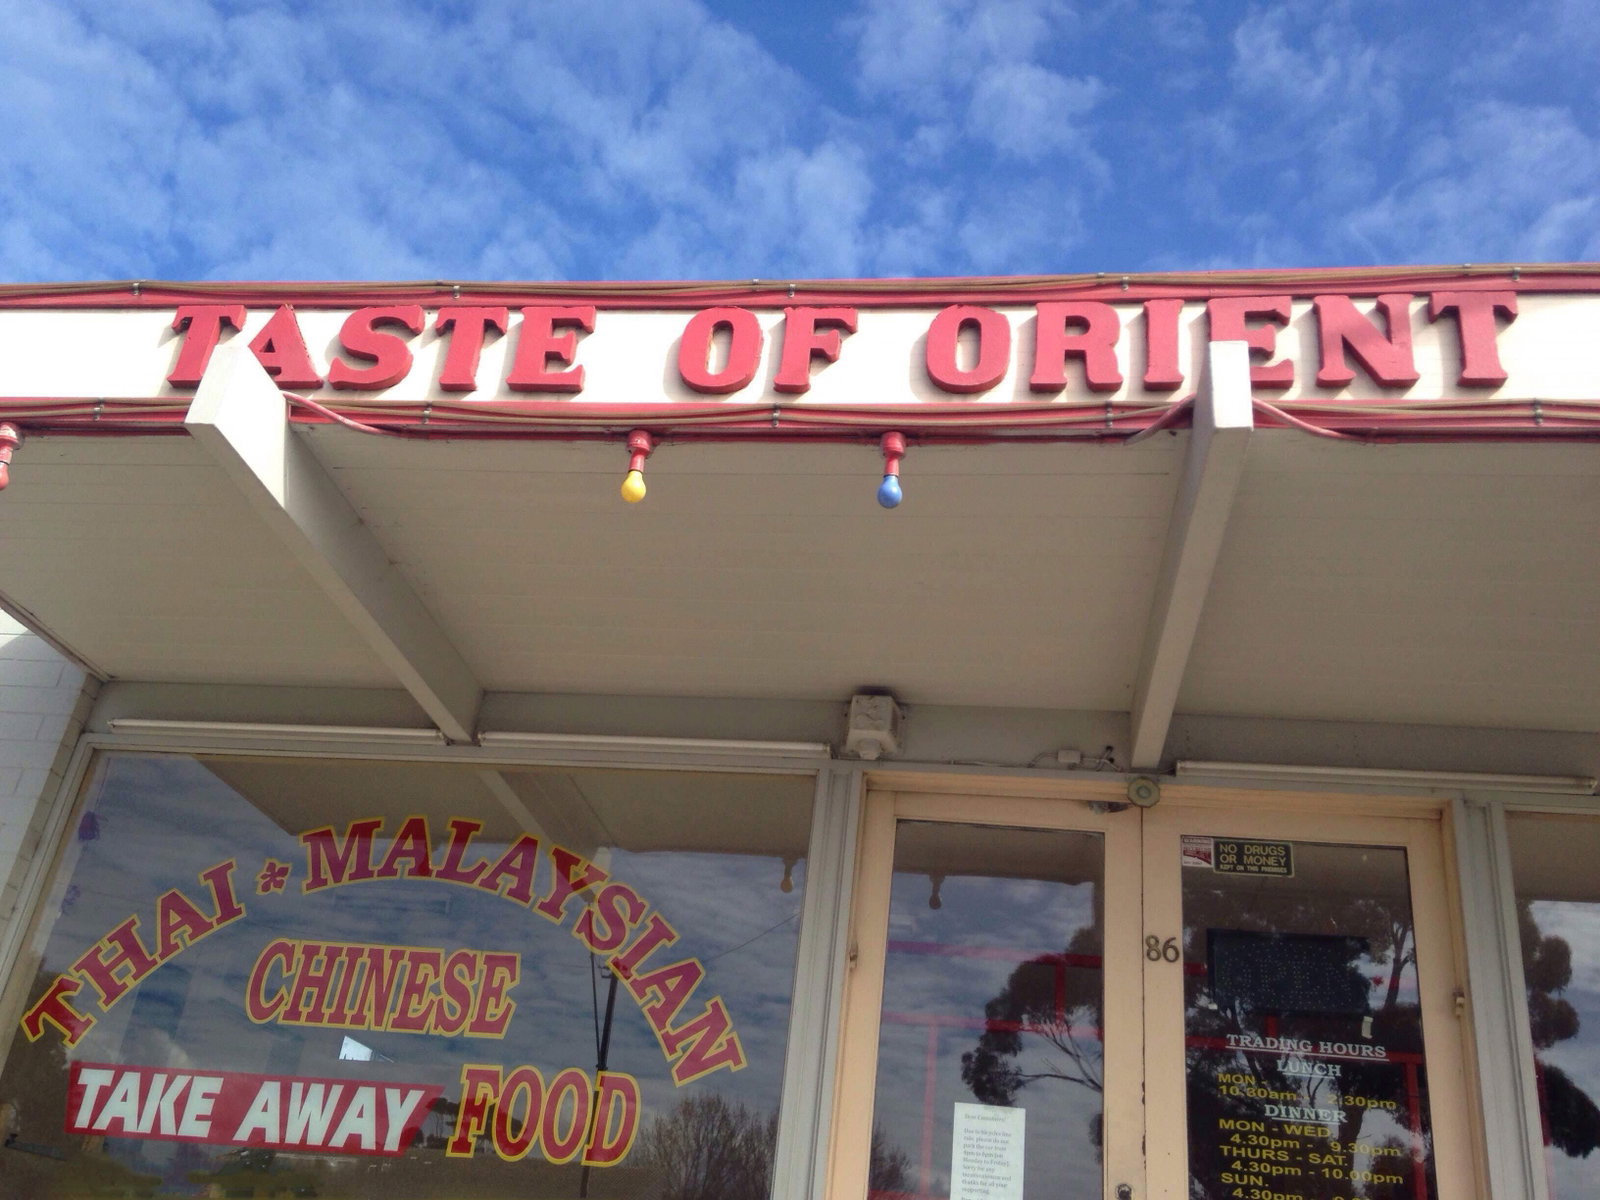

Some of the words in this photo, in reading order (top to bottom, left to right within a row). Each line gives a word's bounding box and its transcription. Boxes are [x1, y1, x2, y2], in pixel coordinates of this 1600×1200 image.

[167, 304, 596, 394] TASTE
[678, 306, 858, 394] OF
[927, 291, 1518, 394] ORIENT
[1220, 843, 1237, 853] NO
[1244, 844, 1286, 855] DRUGS
[1220, 854, 1237, 864] OR
[1243, 855, 1286, 867] MONEY
[20, 857, 246, 1048] THAI
[300, 814, 747, 1088] MALAYSIAN
[1145, 935, 1180, 963] 86
[246, 938, 521, 1039] CHINESE
[1226, 1034, 1313, 1052] TRADING
[1319, 1041, 1387, 1058] HOURS
[1217, 1073, 1256, 1085] MON
[1277, 1059, 1341, 1077] LUNCH
[74, 1068, 224, 1137] TAKE
[233, 1081, 425, 1151] AWAY
[445, 1064, 641, 1167] FOOD
[1265, 1104, 1348, 1123] DINNER
[1219, 1119, 1265, 1132] MON
[1219, 1146, 1289, 1161] THURS
[1308, 1153, 1348, 1166] SAT.
[1230, 1134, 1300, 1149] 4.30pm
[1330, 1141, 1401, 1157] 9.30pm
[1220, 1173, 1269, 1187] SUN.
[1231, 1161, 1301, 1176] 4.30pm
[1321, 1168, 1403, 1185] 10.00pm
